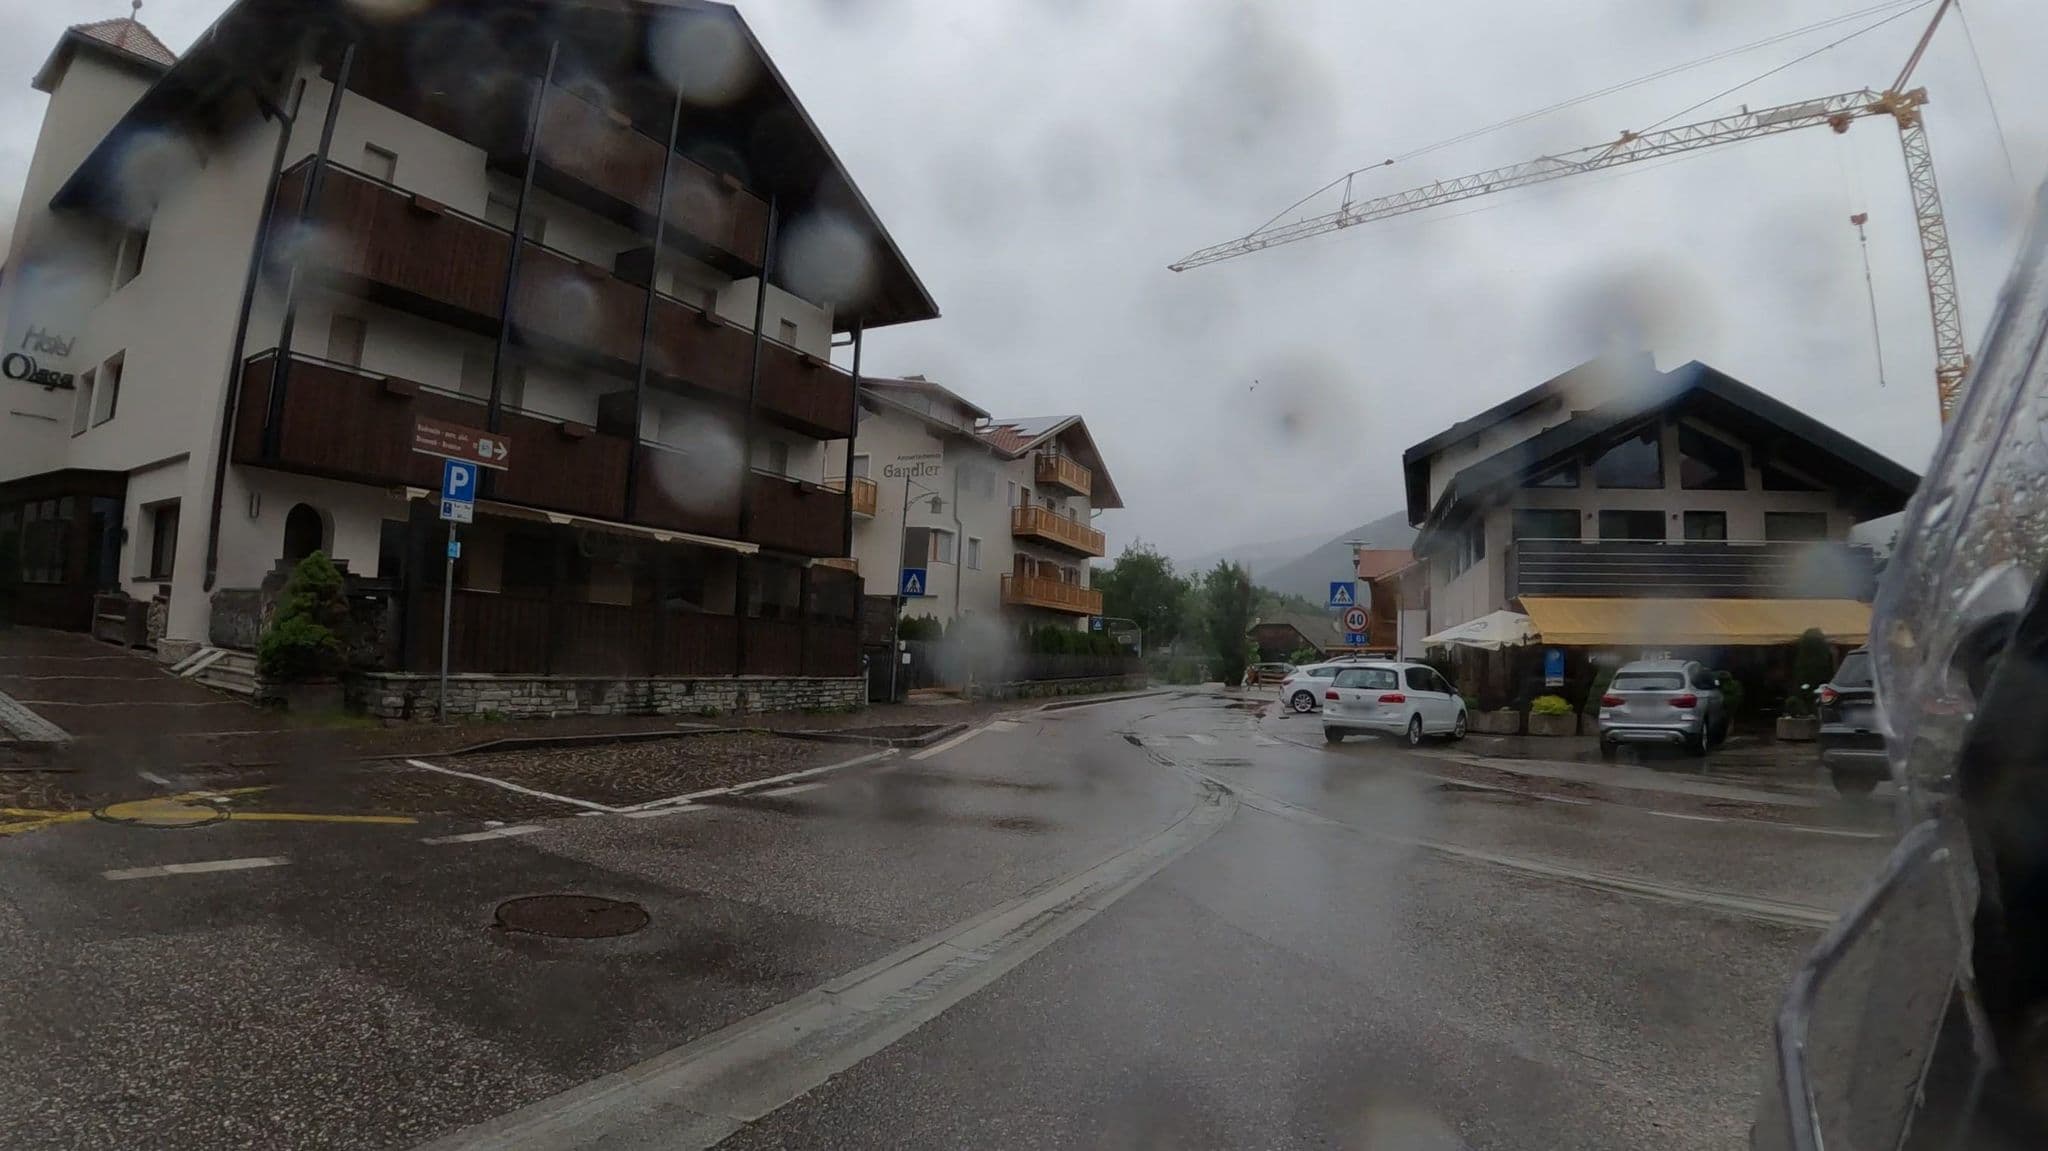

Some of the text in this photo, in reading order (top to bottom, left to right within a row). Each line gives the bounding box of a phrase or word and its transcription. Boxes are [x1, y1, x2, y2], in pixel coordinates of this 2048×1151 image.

[883, 462, 942, 478] Gandler
[449, 466, 469, 496] P
[1349, 613, 1364, 626] 40
